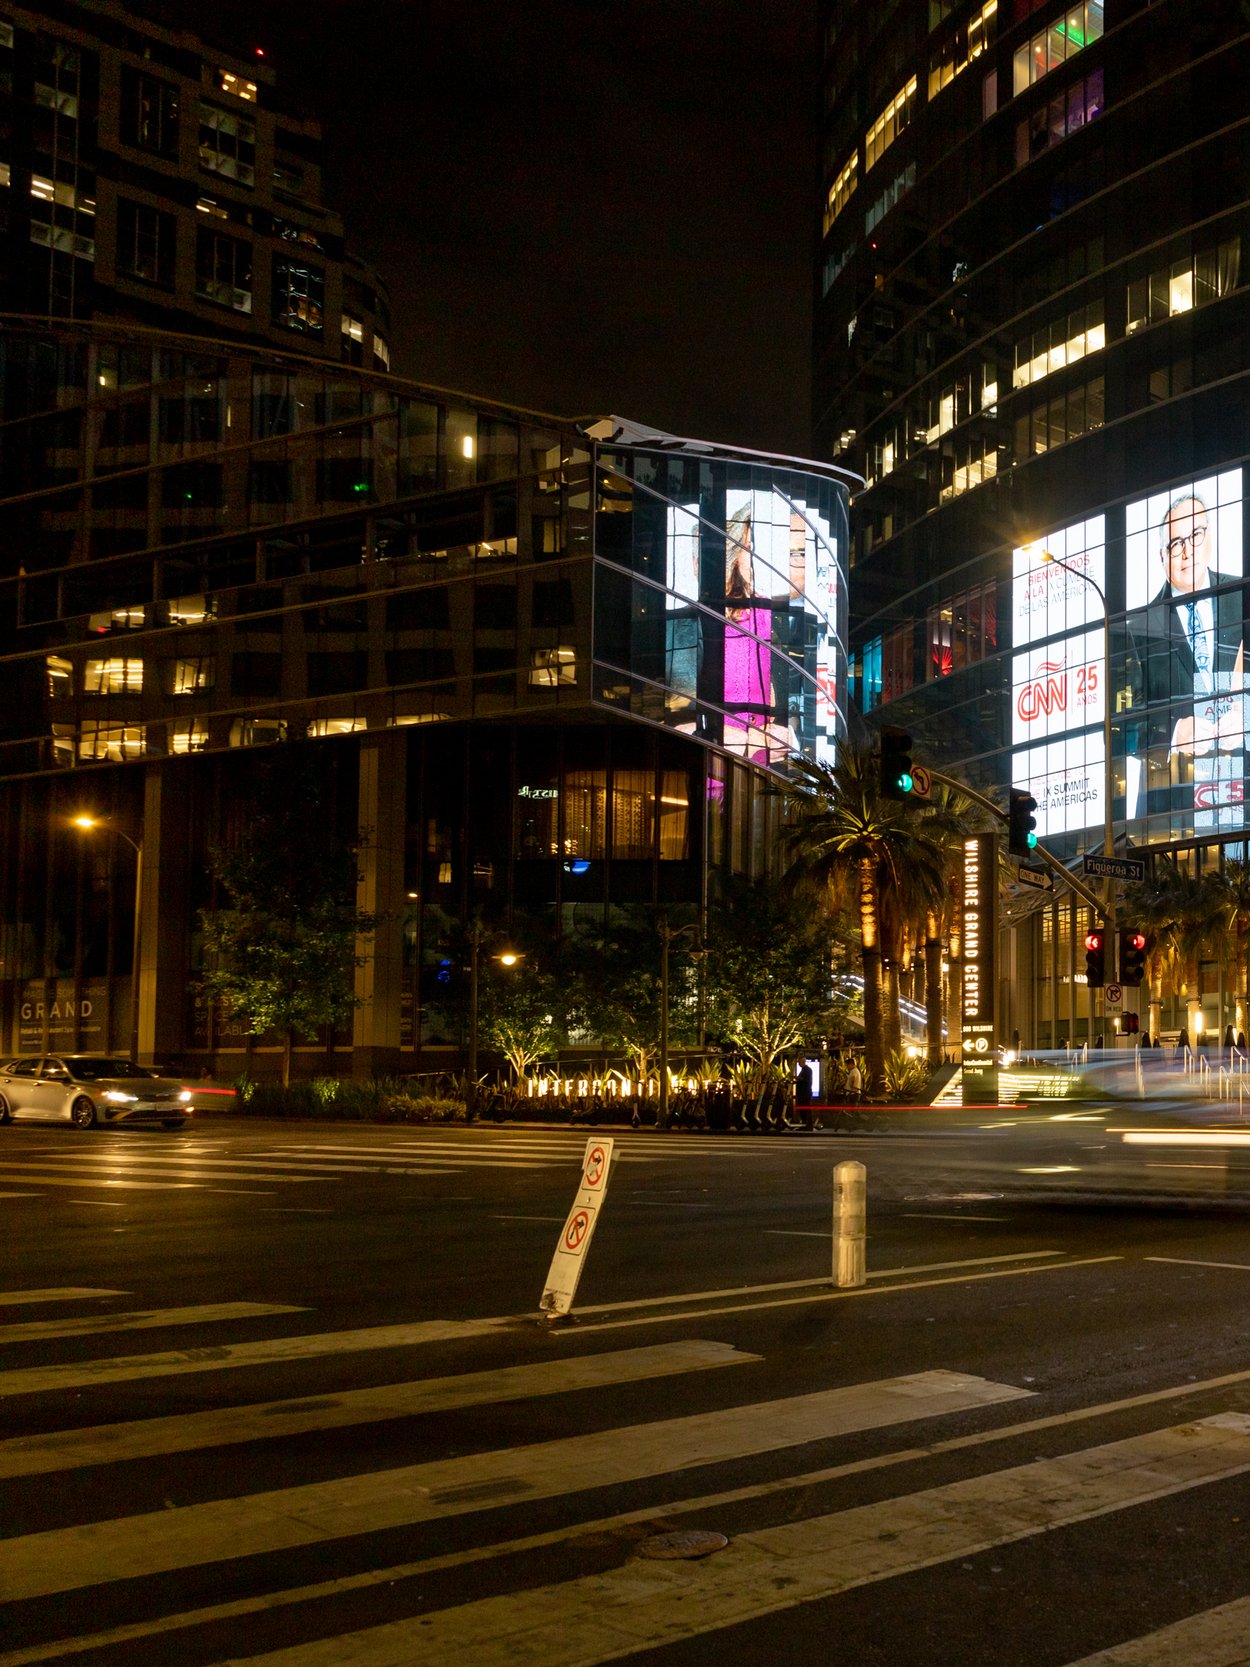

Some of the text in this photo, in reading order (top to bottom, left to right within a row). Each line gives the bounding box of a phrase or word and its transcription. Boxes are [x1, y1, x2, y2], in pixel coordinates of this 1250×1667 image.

[1017, 664, 1098, 722] CNN 25
[1053, 777, 1091, 795] SUMMIT
[1050, 788, 1098, 810] AMERICAS
[1086, 860, 1141, 878] Figueroa St
[964, 839, 979, 1016] WILSHIRE GRAND CENTER
[20, 1000, 93, 1020] GRAND
[194, 1010, 230, 1022] SPCE
